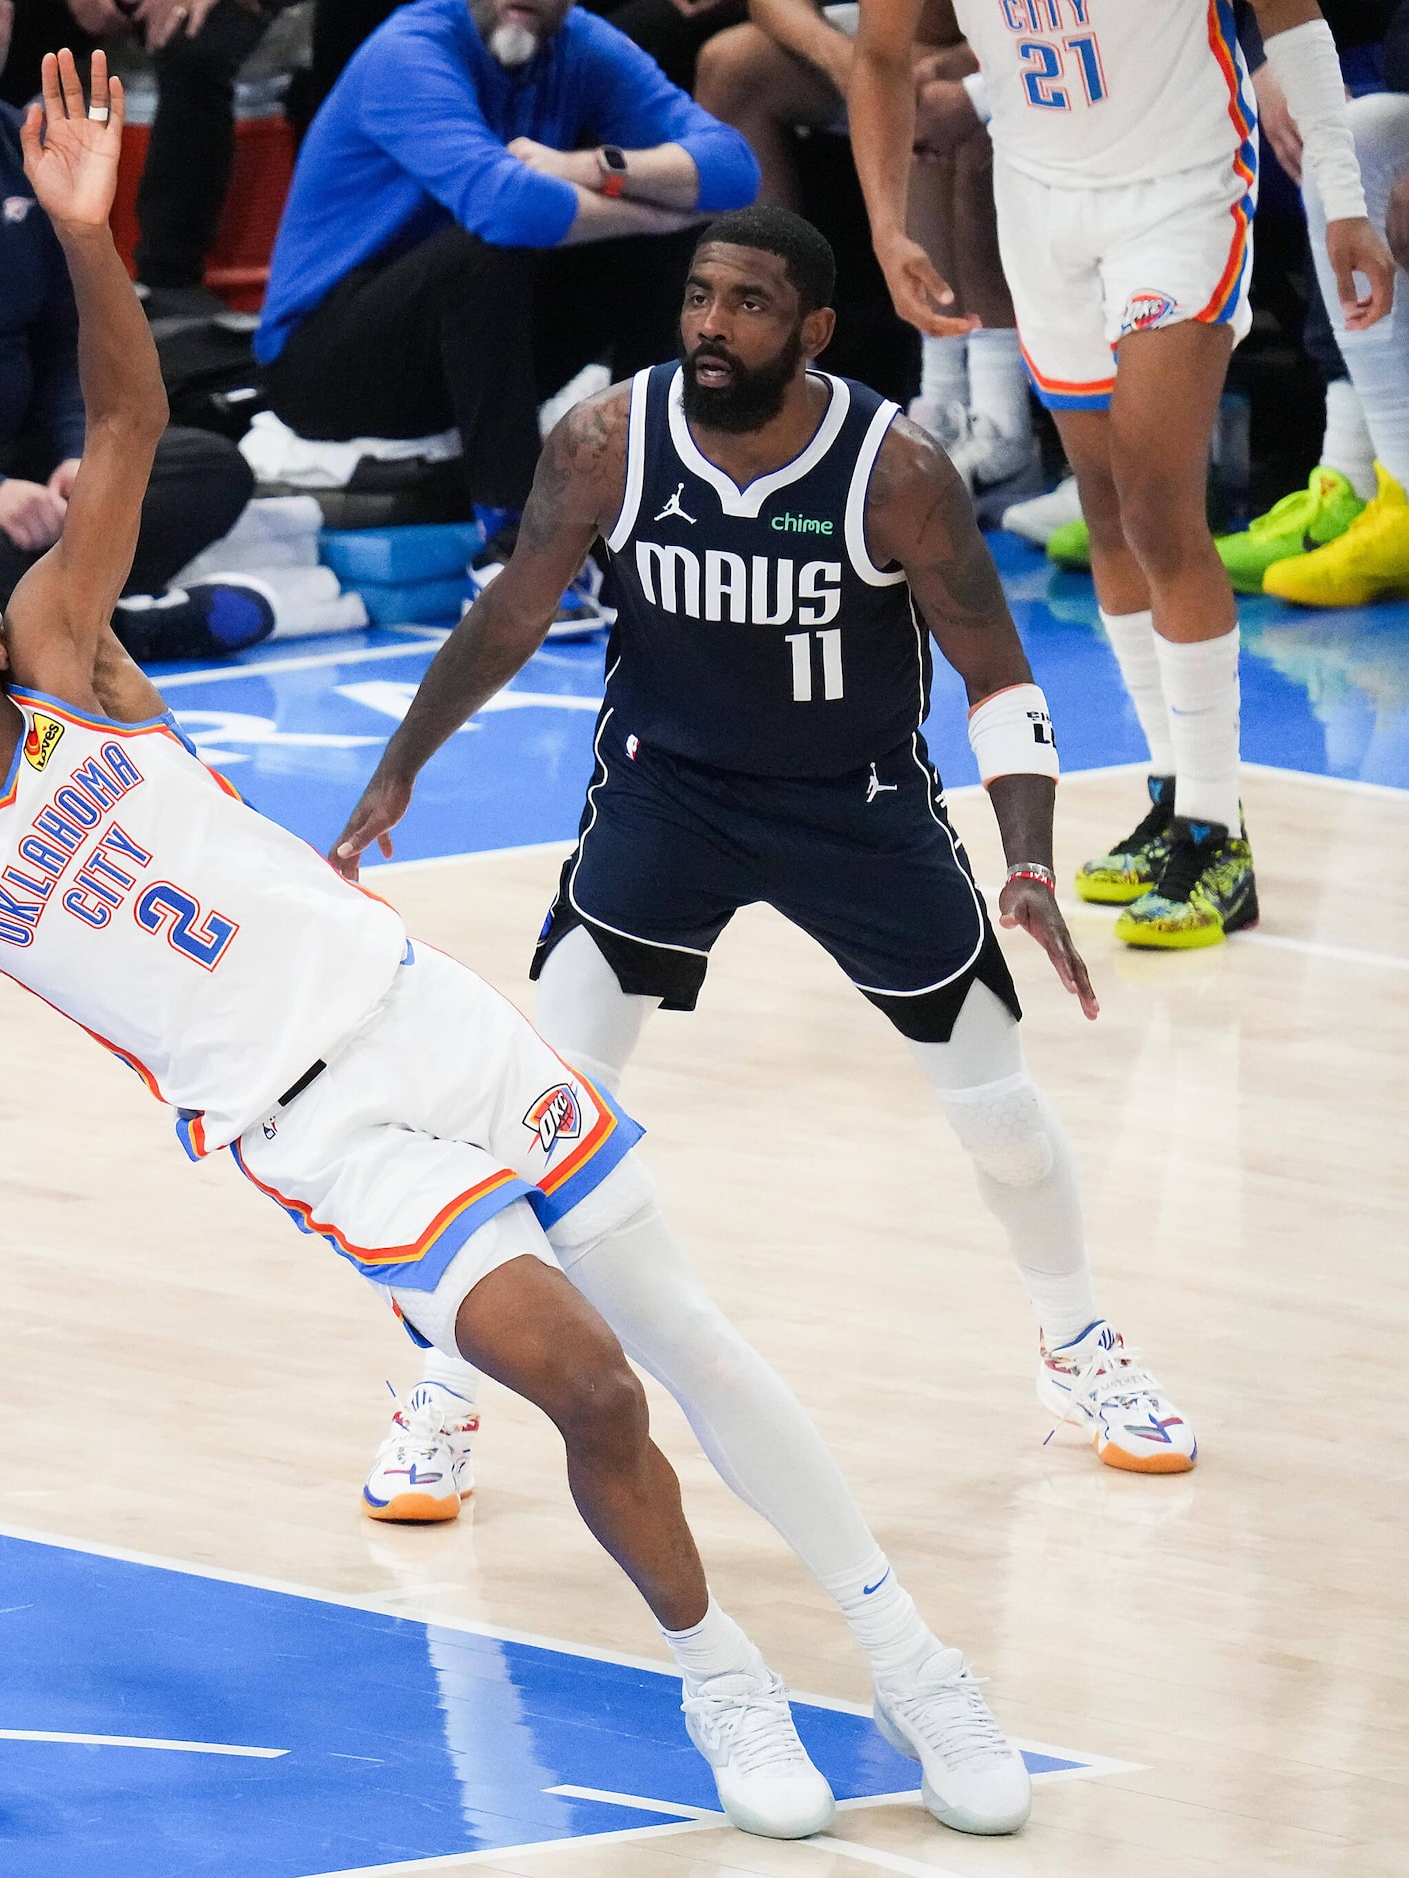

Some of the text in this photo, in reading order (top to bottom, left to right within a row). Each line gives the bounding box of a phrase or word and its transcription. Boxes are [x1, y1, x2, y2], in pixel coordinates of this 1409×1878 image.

[999, 0, 1090, 32] CITY
[1016, 31, 1109, 111] 21
[771, 512, 834, 535] chime
[635, 540, 842, 626] MAVS
[785, 628, 844, 702] 11
[62, 821, 153, 929] CITY
[133, 880, 240, 973] 2
